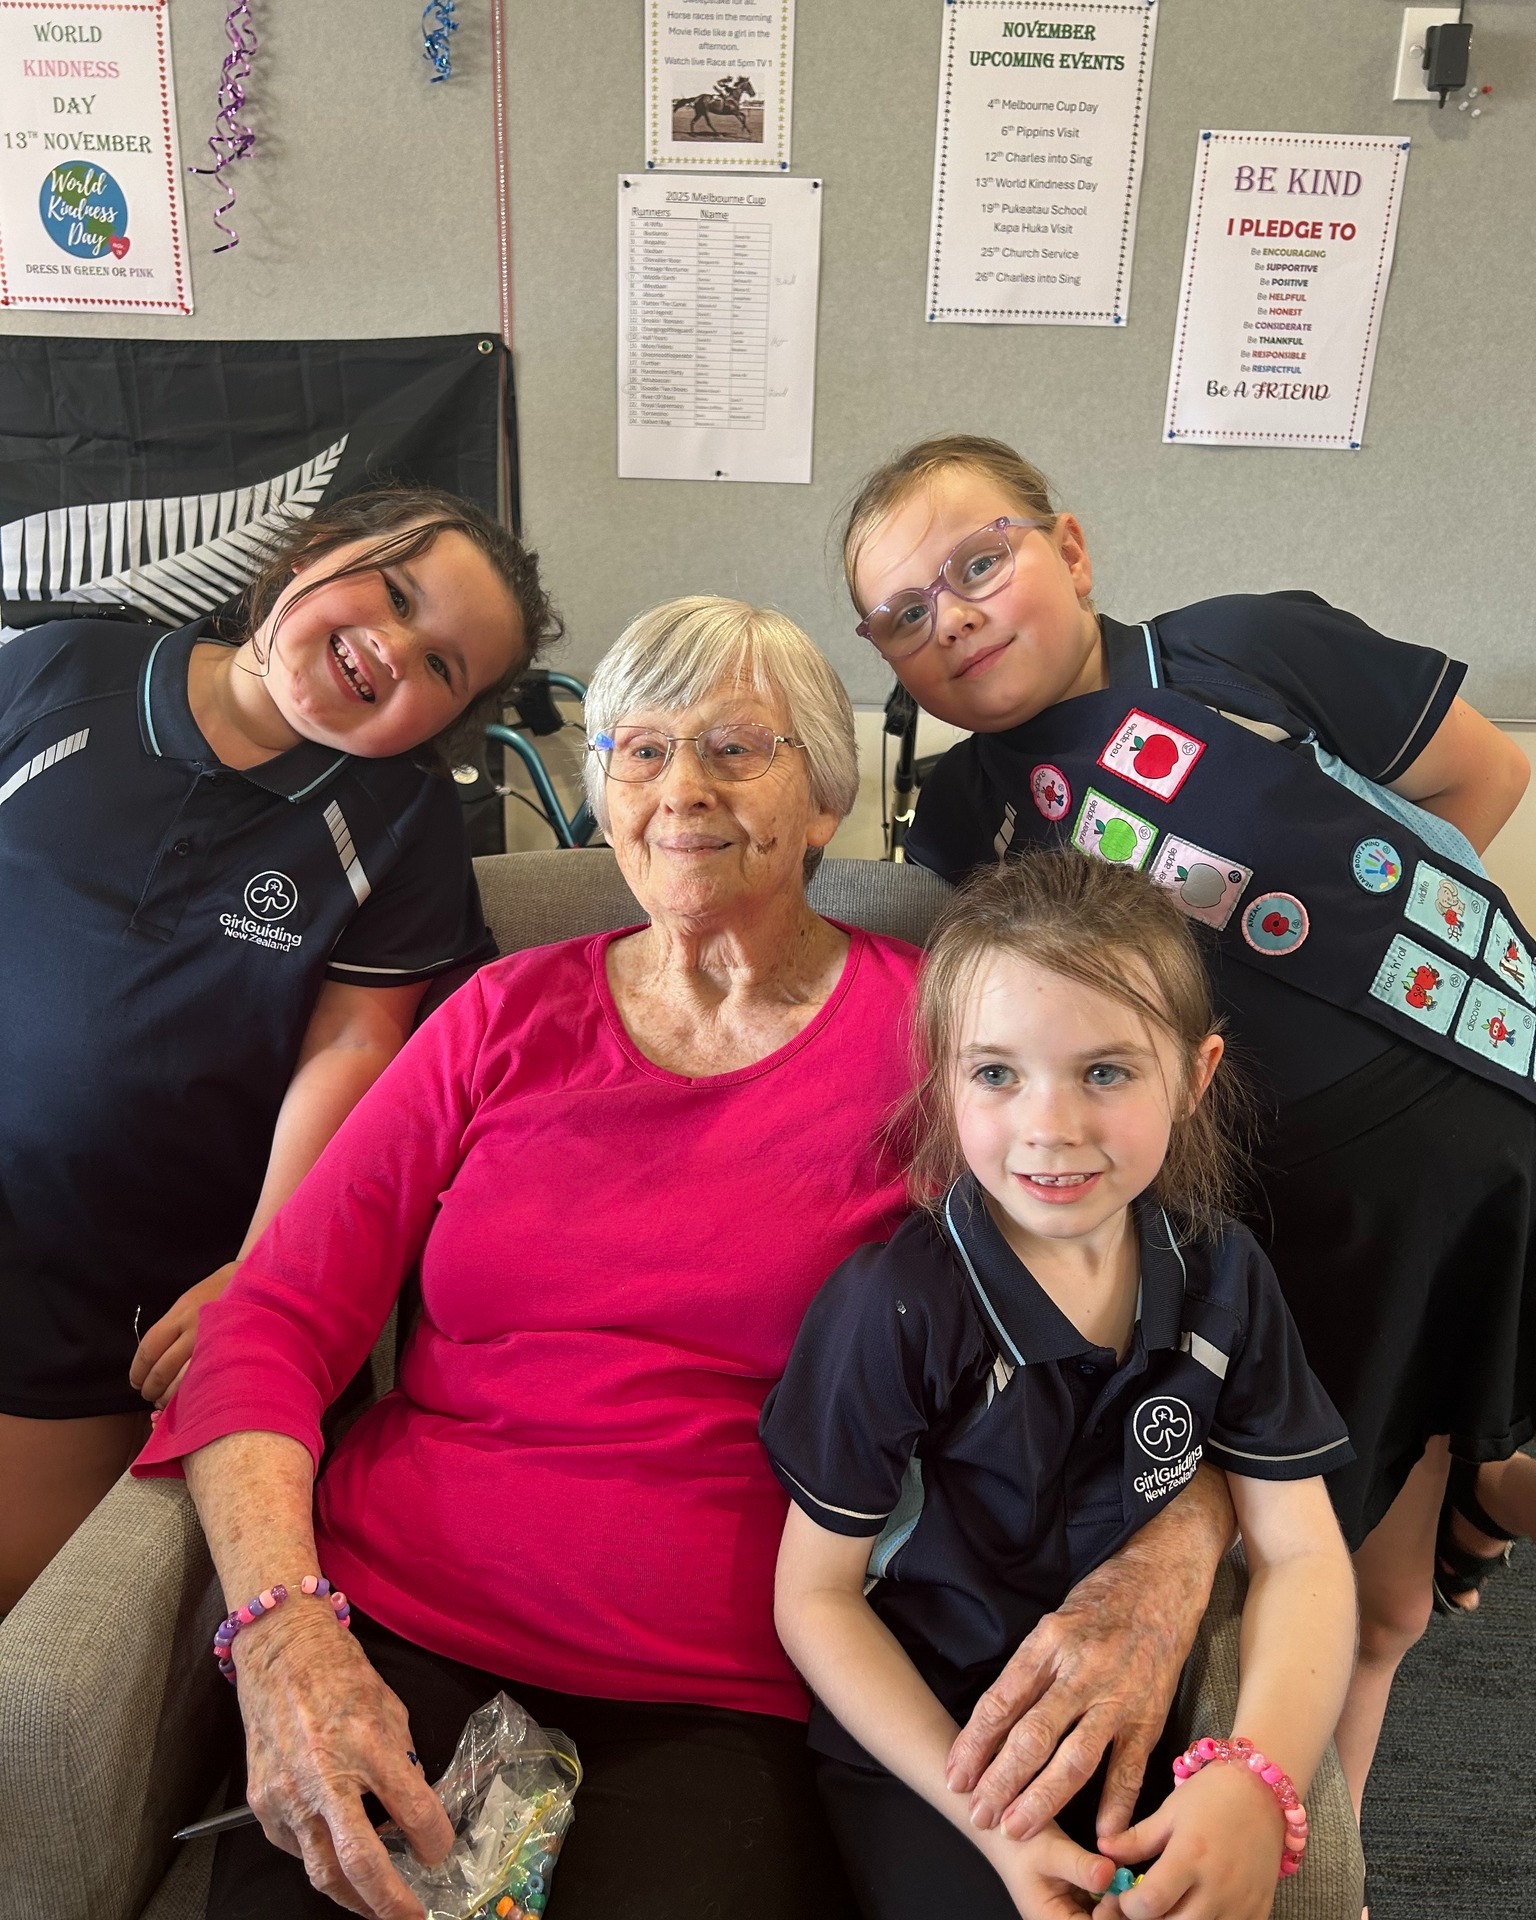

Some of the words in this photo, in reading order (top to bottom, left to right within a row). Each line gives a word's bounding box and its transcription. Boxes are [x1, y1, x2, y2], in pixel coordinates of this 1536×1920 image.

[667, 11, 691, 20] Horse
[716, 12, 723, 20] in
[725, 12, 738, 20] the
[739, 13, 772, 24] morning
[33, 21, 102, 43] WORLD
[668, 27, 692, 36] Movie
[694, 28, 711, 36] Ride
[712, 28, 726, 36] like
[734, 29, 746, 38] girl
[1002, 20, 1096, 42] NOVEMBER
[699, 42, 740, 50] afternoon.
[23, 59, 120, 78] KINDNESS
[664, 56, 690, 65] Watch
[691, 57, 704, 66] live
[706, 58, 726, 66] Race
[728, 58, 736, 66] at
[737, 59, 756, 68] 5pm
[756, 59, 767, 68] TV
[768, 60, 772, 68] 1
[970, 50, 1055, 68] UPCOMING
[1059, 51, 1126, 71] EVENTS
[53, 94, 96, 114] DAY
[987, 98, 1000, 110] 4th
[1002, 100, 1054, 111] Melbourne
[1056, 101, 1077, 114] Cup
[1078, 102, 1099, 114] Day
[1001, 125, 1015, 136] 6th
[1016, 126, 1055, 139] Pippins
[1056, 127, 1080, 138] Visit
[4, 131, 38, 149] 13TH
[44, 131, 152, 154] NOVEMBER
[985, 151, 1004, 162] 12th
[1005, 152, 1046, 164] Charles
[1048, 153, 1068, 164] into
[1070, 154, 1093, 166] Sing
[51, 168, 108, 196] World
[976, 176, 994, 188] 13th
[996, 178, 1027, 188] World
[1028, 178, 1075, 190] Kindness
[1077, 180, 1098, 192] Day
[1234, 165, 1278, 193] BE
[1286, 167, 1363, 197] KIND
[666, 191, 690, 202] 2025
[692, 192, 745, 204] Melbourne
[746, 194, 766, 206] Cup
[48, 195, 118, 223] Kindness
[632, 206, 671, 218] Runners
[700, 210, 729, 220] Name
[982, 203, 1000, 214] 19th
[1002, 204, 1049, 215] Pukeatau
[1050, 204, 1088, 216] School
[994, 222, 1020, 234] Kapa
[1021, 223, 1048, 234] Huka
[1050, 224, 1074, 234] Visit
[1227, 218, 1234, 236] I
[1240, 218, 1324, 240] PLEDGE
[1328, 222, 1357, 241] TO
[68, 222, 107, 256] Day
[980, 246, 1000, 258] 25th
[1002, 248, 1040, 258] Church
[1040, 248, 1080, 259] Service
[1250, 248, 1262, 256] Be
[1262, 248, 1326, 258] ENCOURAGING
[26, 264, 59, 274] DRESS
[61, 265, 72, 275] IN
[74, 266, 110, 276] GREEN
[112, 267, 128, 277] OR
[130, 268, 154, 278] PINK
[1266, 264, 1318, 272] SUPPORTIVE
[975, 272, 994, 282] 26th
[996, 272, 1036, 283] Charles
[1037, 273, 1057, 284] into
[1058, 274, 1082, 286] Sing
[1260, 278, 1270, 286] Be
[1272, 278, 1308, 288] POSITIVE
[1256, 292, 1268, 300] Be
[1268, 293, 1307, 302] HELPFUL
[1268, 308, 1303, 316] HONEST
[1254, 322, 1312, 331] CONSIDERATE
[1258, 336, 1304, 346] THANKFUL
[1252, 351, 1307, 360] RESPONSIBLE
[1252, 365, 1302, 374] RESPECTFUL
[1206, 380, 1230, 398] Be
[1234, 380, 1250, 398] A
[1252, 381, 1331, 402] FRIEND
[1110, 742, 1122, 758] red
[1120, 723, 1138, 743] apple
[1079, 822, 1090, 846] green
[1086, 800, 1098, 821] apple
[1164, 848, 1178, 870] apple
[1354, 851, 1362, 868] BODY
[1356, 870, 1374, 889] HEART,
[1418, 880, 1430, 904] wildlife
[1248, 904, 1262, 928] ANZAC
[220, 914, 302, 946] GirlGuiding
[224, 927, 248, 940] New
[248, 933, 291, 952] Zealand
[1383, 972, 1398, 992] rock
[1398, 946, 1407, 960] roll
[1467, 998, 1482, 1031] discover
[1134, 1444, 1204, 1493] GirlGuiding
[1144, 1486, 1167, 1503] New
